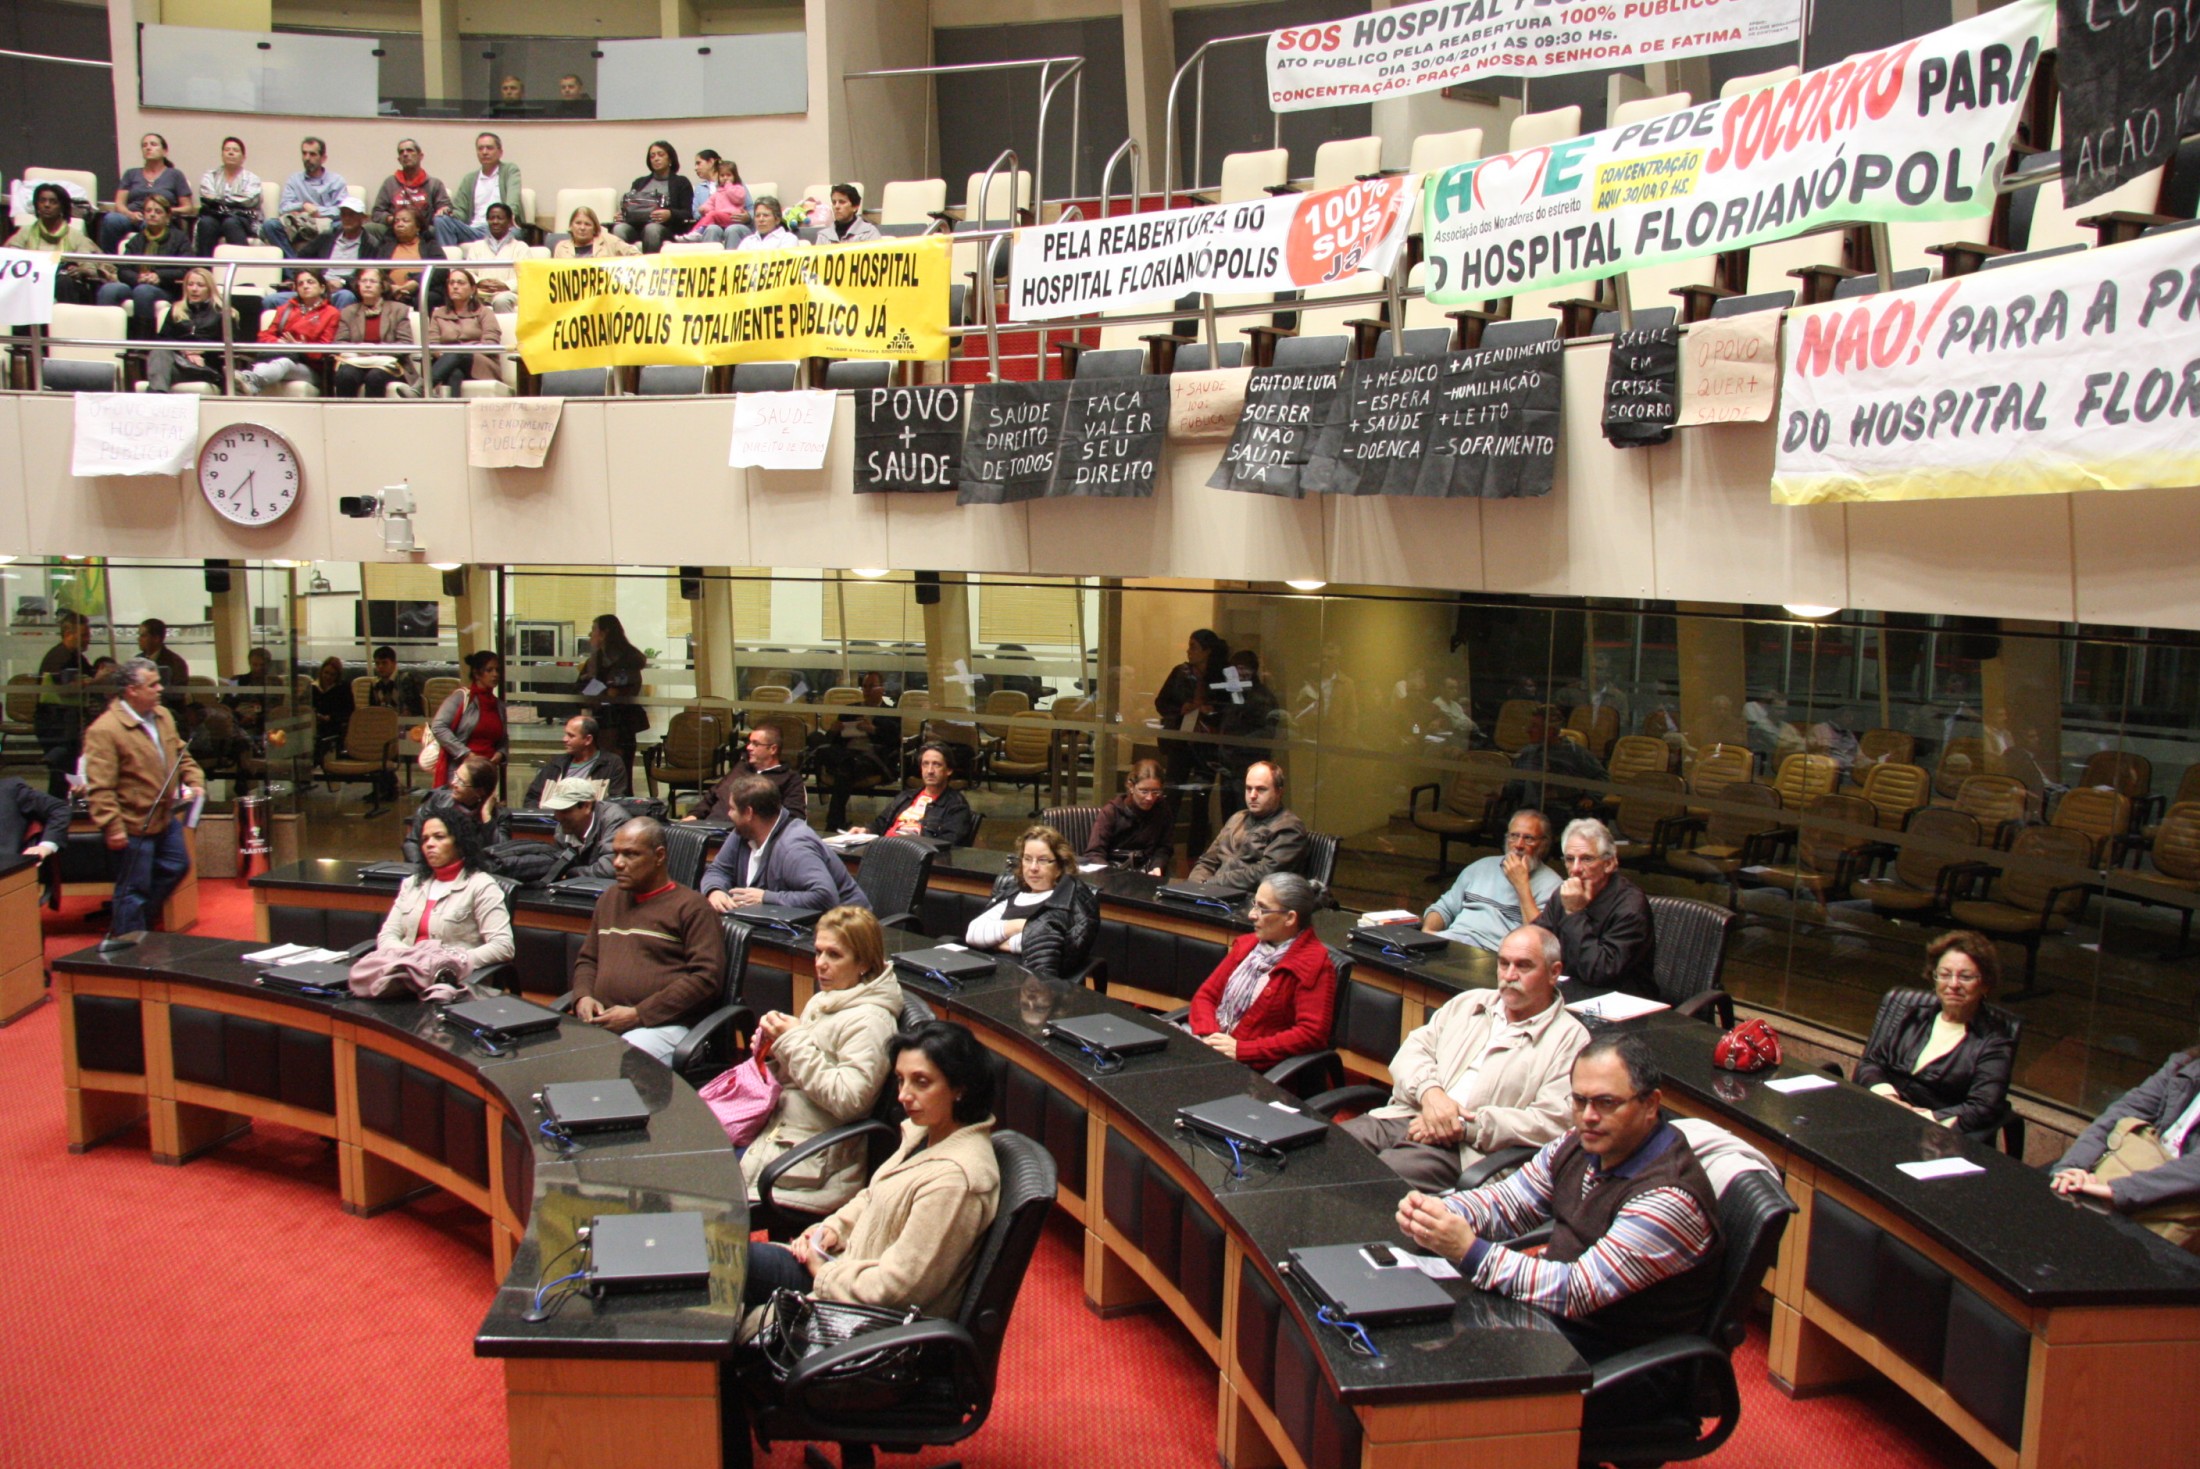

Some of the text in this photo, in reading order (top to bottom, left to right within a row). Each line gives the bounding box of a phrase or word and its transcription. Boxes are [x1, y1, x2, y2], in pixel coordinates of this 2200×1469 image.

[1277, 0, 1503, 51] SOS HOSPITAL
[1277, 58, 1308, 69] ATO
[1313, 51, 1387, 69] PUBLICO
[1393, 42, 1433, 59] PELA
[1439, 16, 1552, 50] REABERTURA
[1560, 6, 1616, 25] 100%
[1272, 28, 1742, 102] CONCENTRAÇÃO: PRAÇA NOSSA SENHORA DE FATIMA
[1378, 29, 1618, 78] DIA 30/04/2011 AS 09:30 Hs.
[1612, 36, 2040, 174] PEDE SOCORRO PARA
[1600, 152, 1698, 185] CONCENTRAÇÃO
[1305, 179, 1389, 236] 100%
[1597, 188, 1622, 209] AQUI
[1312, 203, 1381, 261] SUS
[1434, 197, 1582, 243] Associação dos Moradores do estreito
[1043, 205, 1265, 262] PELA REABERTURA DO
[1461, 217, 1621, 291] HOSPITAL
[549, 252, 919, 304] SINDPREVS/SC DEFENDE A REABERTURA DO HOSPITAL
[1022, 241, 1279, 307] HOSPITAL FLORIANÓPOLIS
[553, 294, 888, 351] FLORIANÓPOLIS TOTALMENTE PÚBLICO JÁ
[1796, 280, 1961, 377] NÃO!
[1937, 289, 2068, 359] PARA
[2083, 280, 2118, 336] A
[1630, 357, 1653, 371] EM
[1699, 338, 1760, 367] O POVO
[1250, 375, 1337, 393] GRITO DE LUTA
[1376, 364, 1438, 389] MÉDICO
[871, 388, 959, 422] POVO
[1242, 404, 1310, 423] SOFRER
[1370, 390, 1430, 412] ESPERA
[1608, 403, 1672, 419] SOCORRO
[989, 402, 1051, 428] SAÚDE
[1085, 413, 1152, 439] VALER
[1363, 412, 1422, 434] SAÚDE
[1782, 408, 1831, 454] DO
[1849, 381, 2047, 449] HOSPITAL
[225, 439, 236, 448] 11
[240, 433, 255, 442] 12
[264, 439, 269, 448] 1
[986, 427, 1048, 452] DIREITO
[1253, 426, 1294, 445] NÃO
[213, 453, 229, 462] 10
[277, 453, 286, 462] 2
[1082, 439, 1128, 460] SEU
[1227, 443, 1295, 469] SAÚDE
[210, 471, 219, 480] 9
[285, 471, 293, 480] 3
[868, 451, 951, 485] SAUDE
[1010, 452, 1054, 476] TODOS
[1076, 461, 1152, 485] DIREITO
[218, 489, 226, 498] 8
[281, 489, 290, 498] 4
[233, 503, 241, 511] 7
[269, 503, 277, 512] 5
